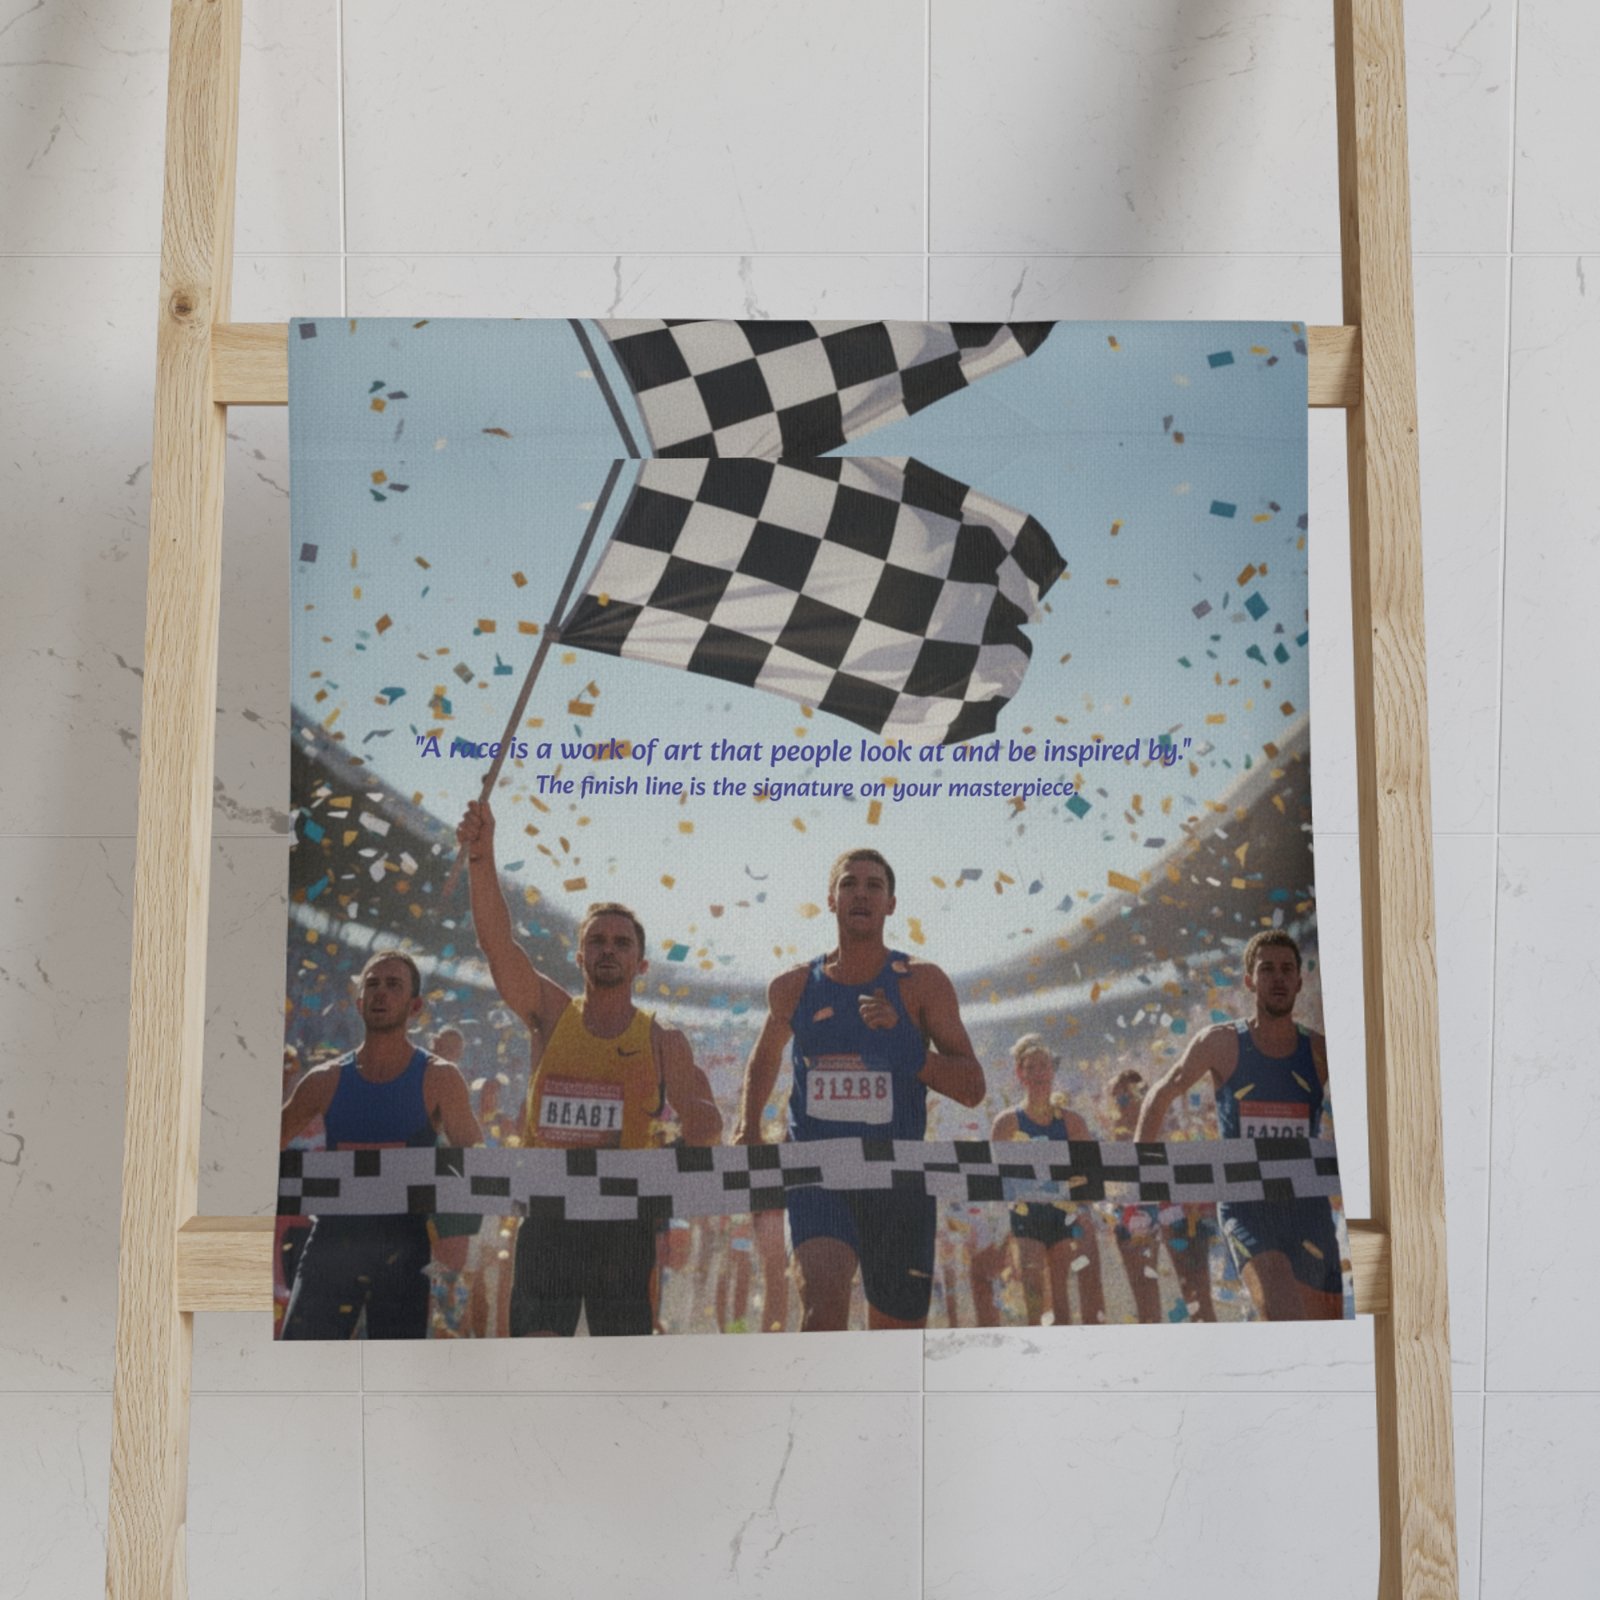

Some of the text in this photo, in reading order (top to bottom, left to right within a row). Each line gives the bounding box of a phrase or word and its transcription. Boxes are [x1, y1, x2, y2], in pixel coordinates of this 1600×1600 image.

[415, 735, 1192, 769] "A race is a work of art that people look at and be inspired by."
[536, 774, 1080, 803] The finish line is the signature on your masterpiece.
